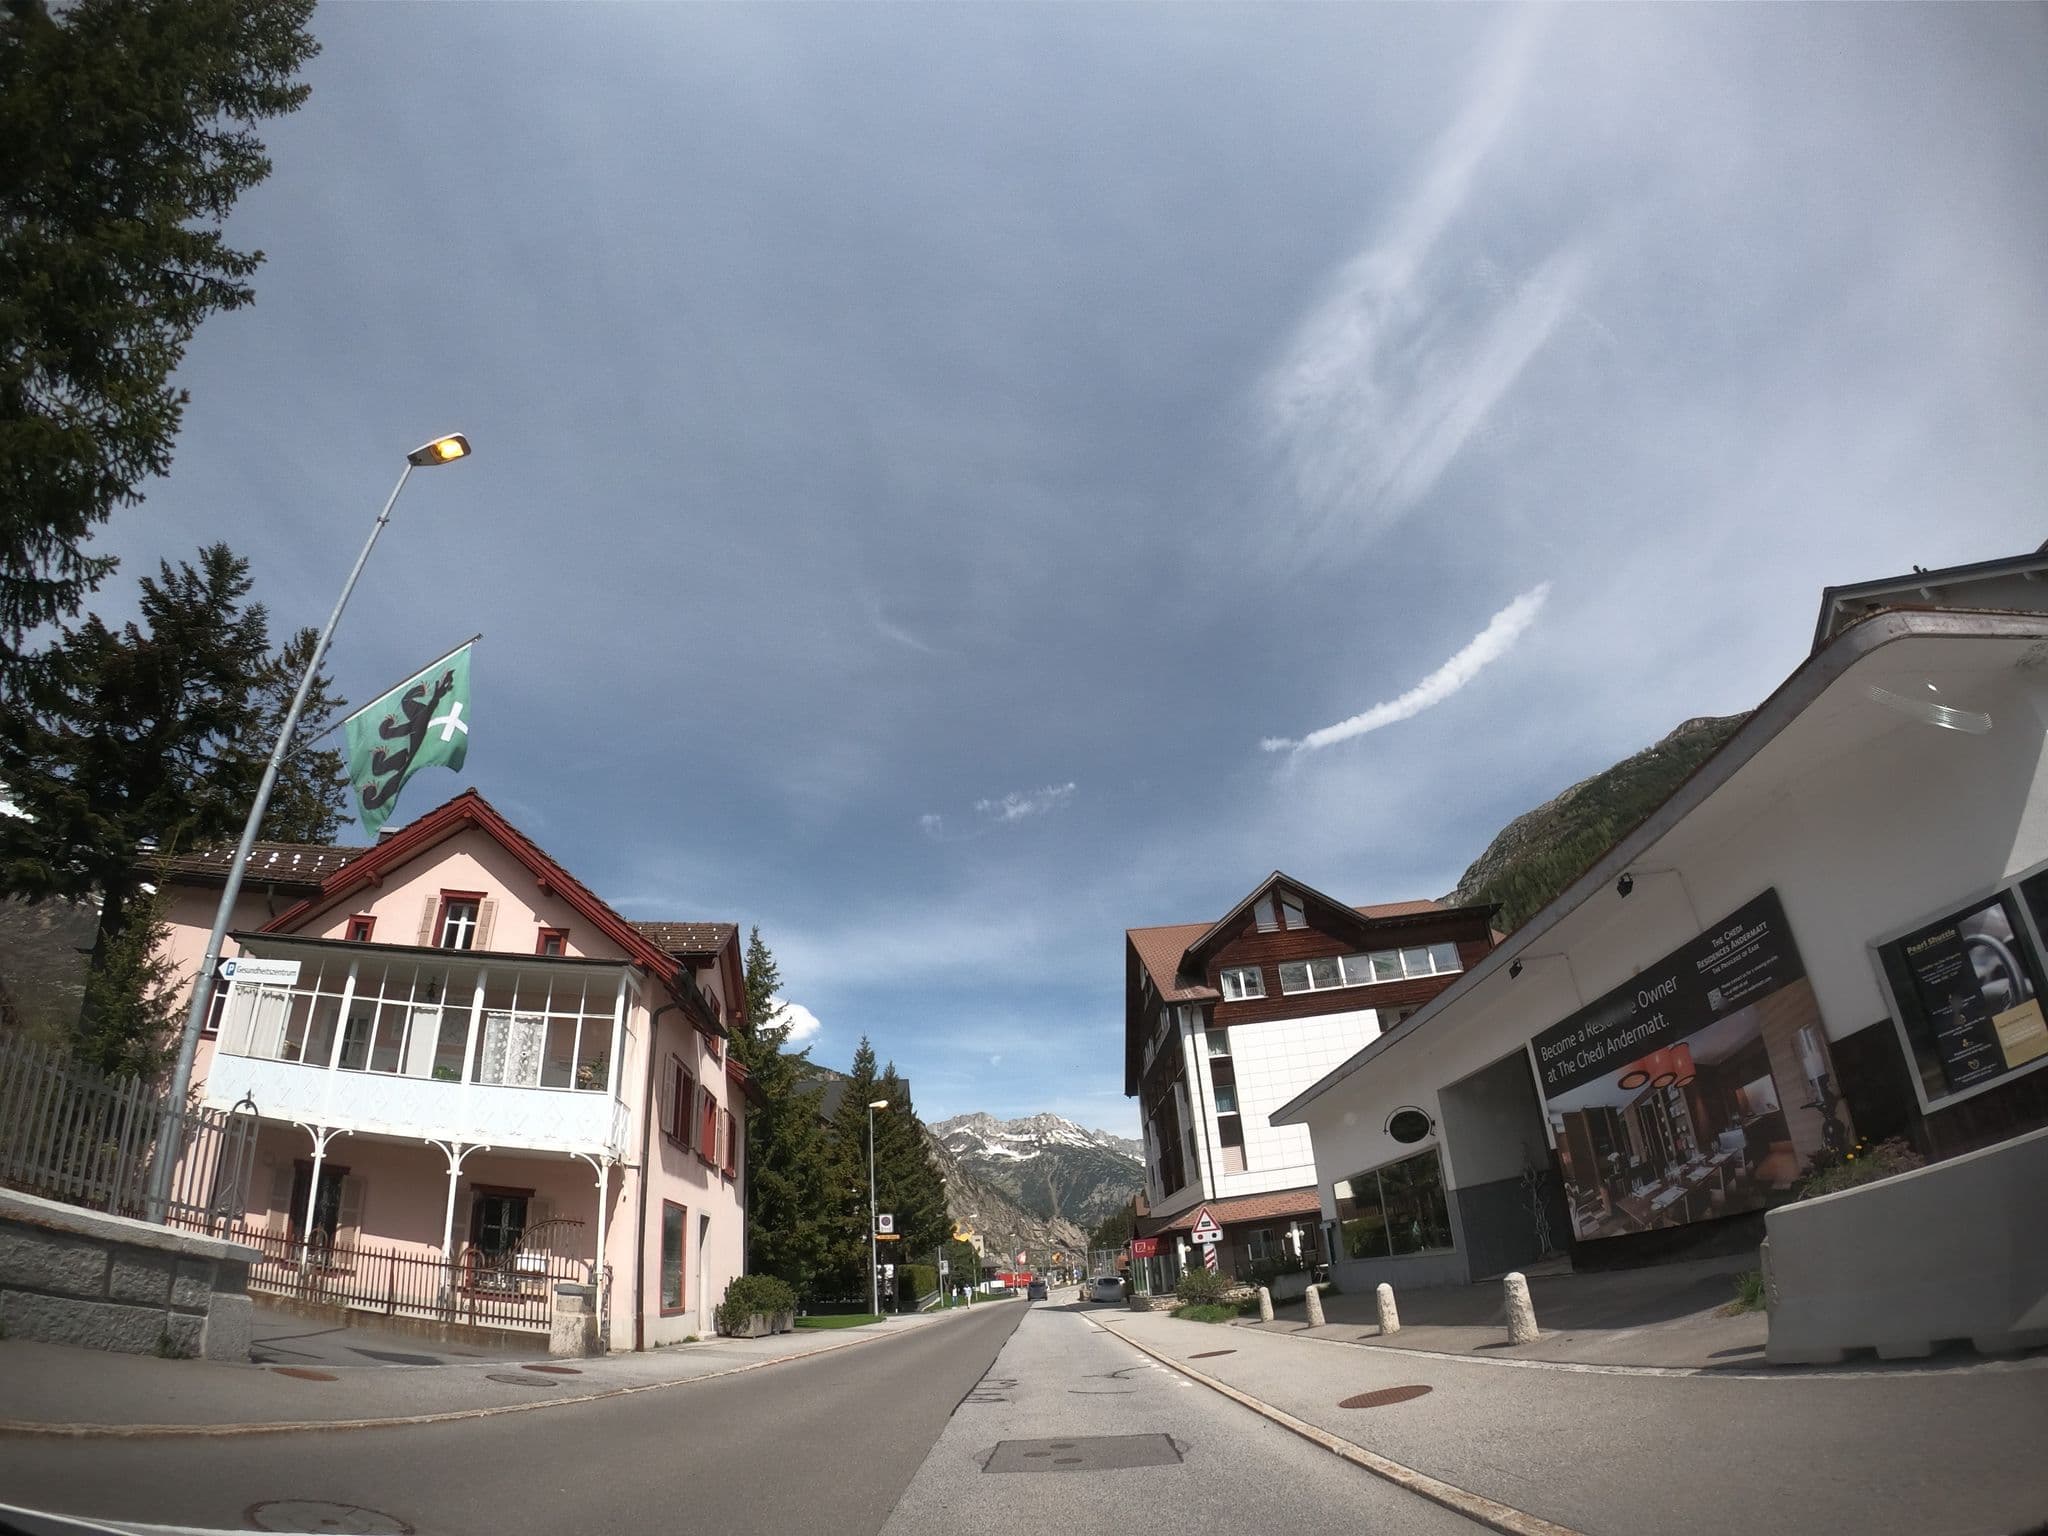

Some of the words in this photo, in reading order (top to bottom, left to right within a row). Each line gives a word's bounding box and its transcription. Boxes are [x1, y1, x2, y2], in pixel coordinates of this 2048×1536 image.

[1696, 945, 1731, 969] RESIDENCES
[1730, 921, 1768, 949] ANDERMATT
[1723, 924, 1743, 941] CHEDI
[1906, 939, 1928, 954] Pearl
[1926, 928, 1957, 946] Shuttle
[236, 965, 298, 978] Gesundheitszentrum
[1540, 1033, 1577, 1062] Become
[1577, 1029, 1586, 1043] a
[1637, 975, 1679, 1009] Owner
[1547, 1066, 1558, 1084] at
[1557, 1058, 1576, 1076] The
[1576, 1041, 1606, 1069] Chedi
[1605, 1012, 1671, 1055] Andermatt.
